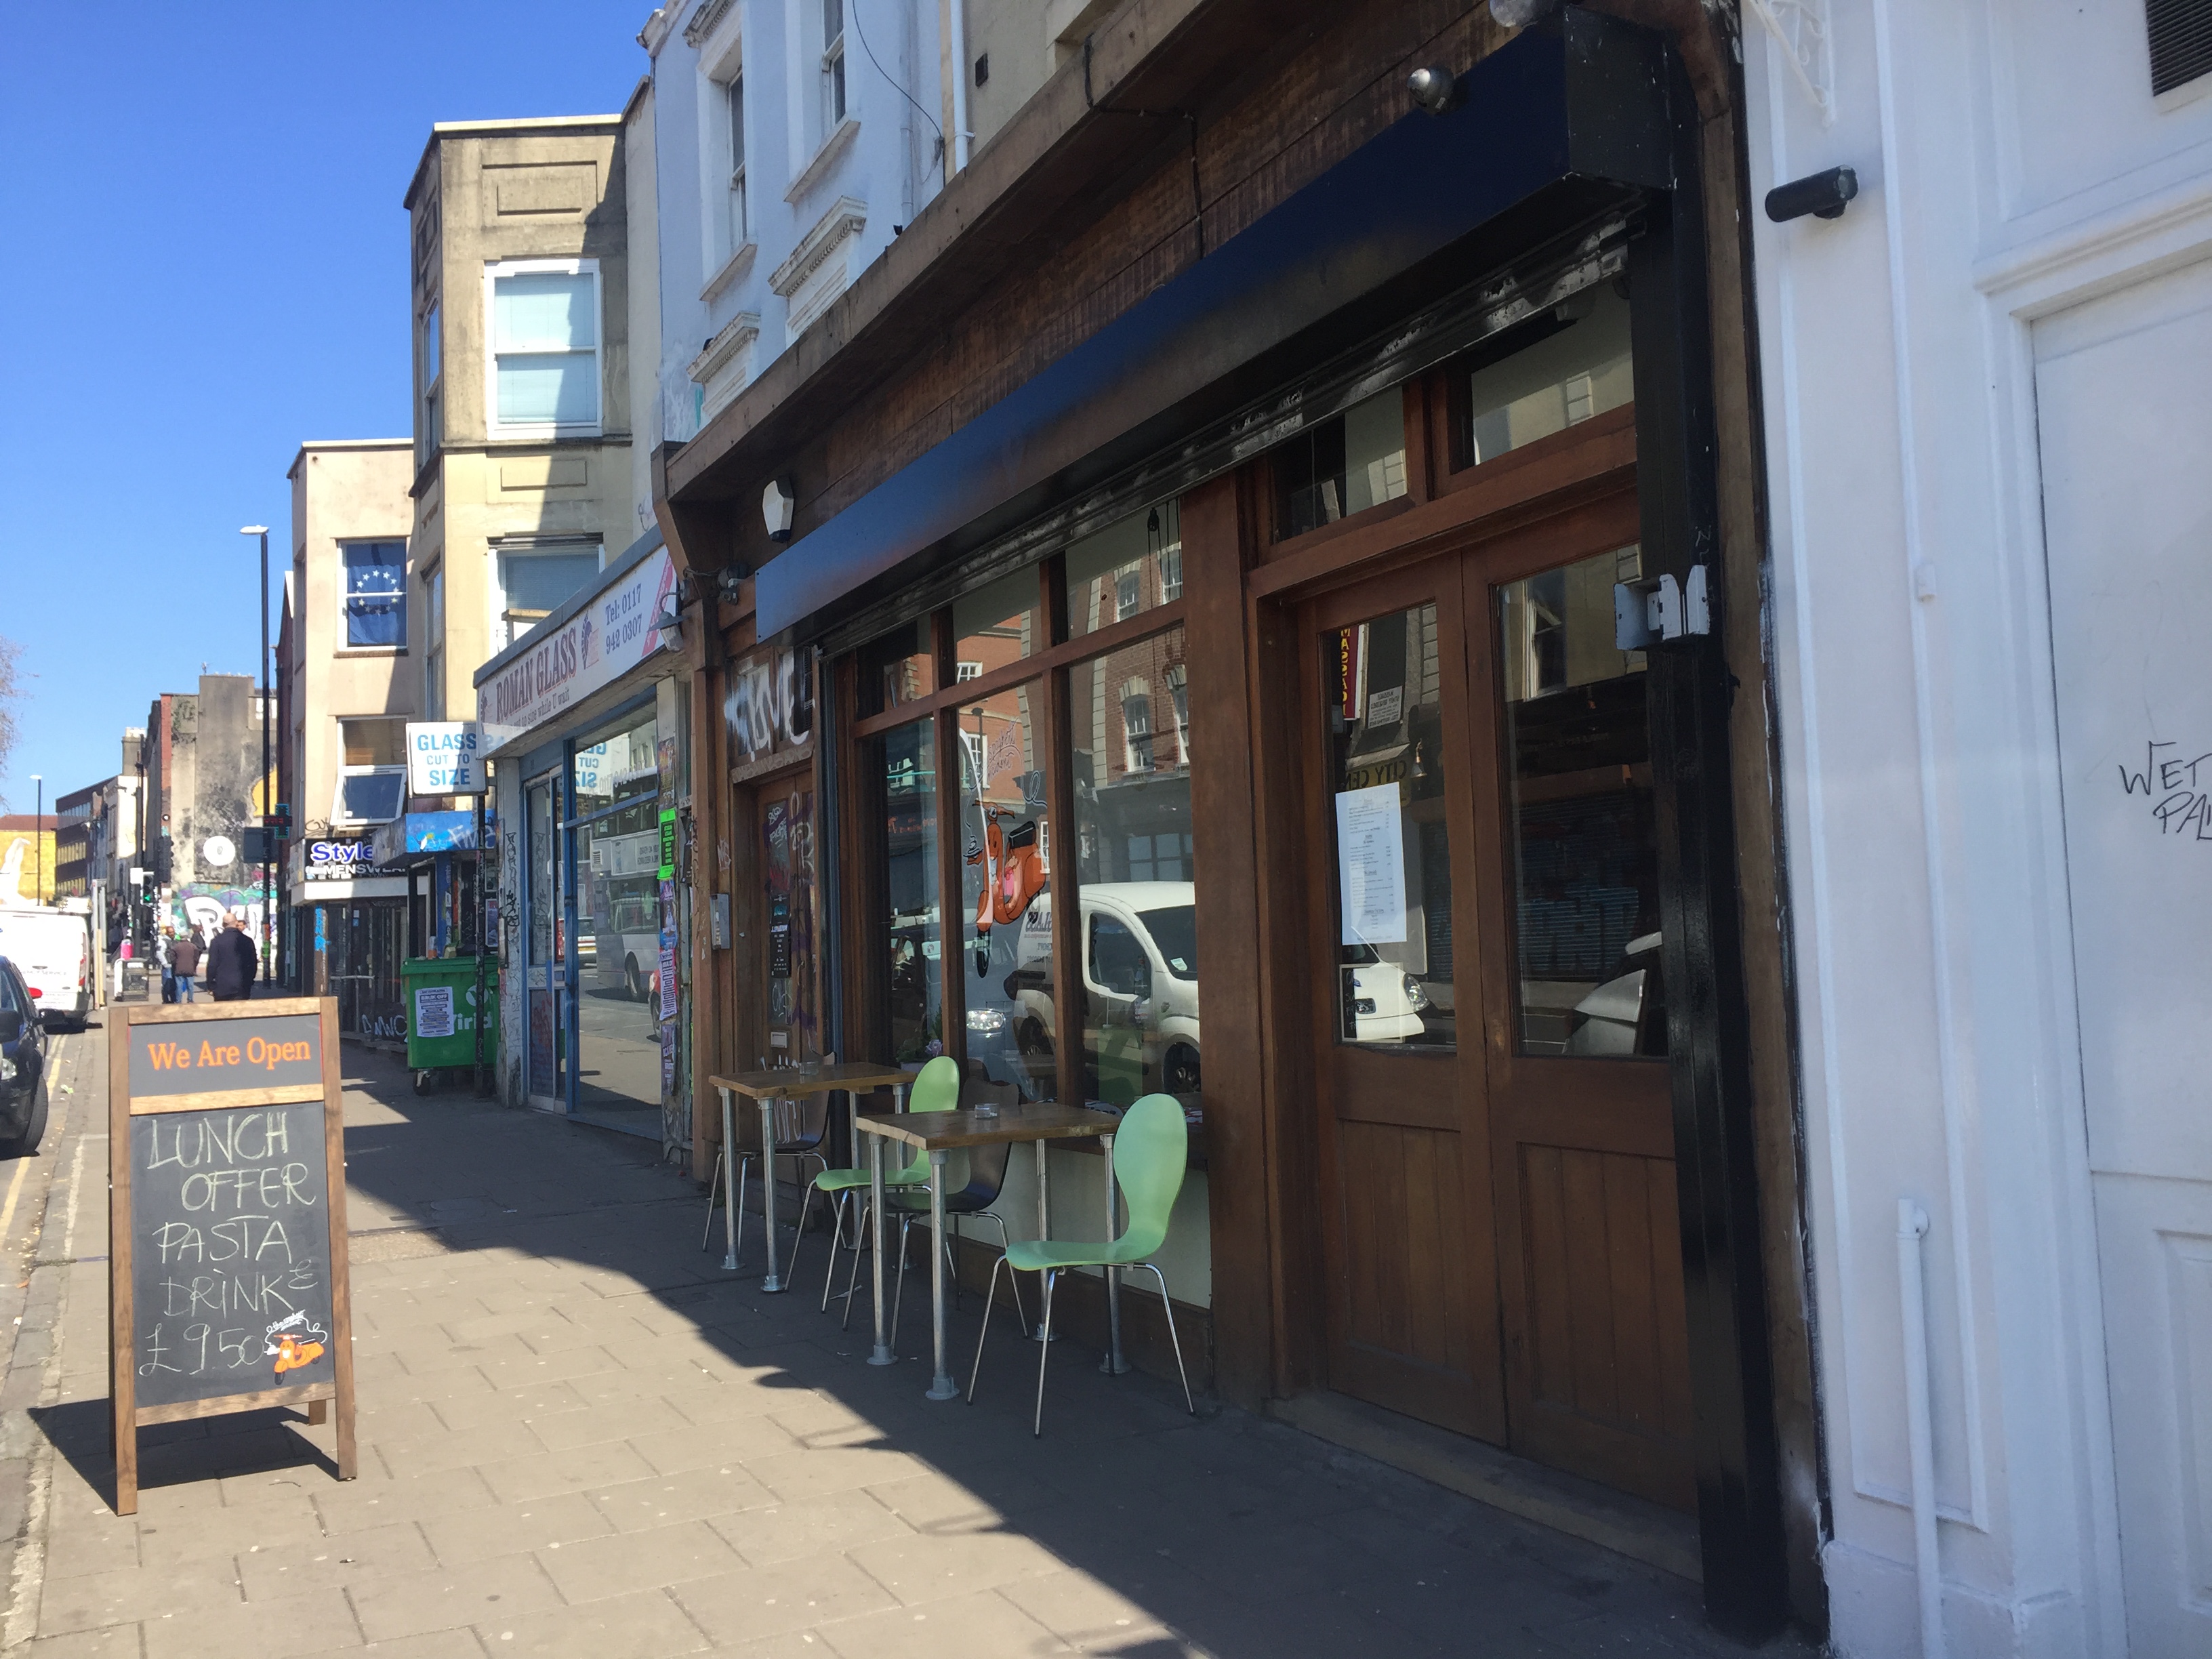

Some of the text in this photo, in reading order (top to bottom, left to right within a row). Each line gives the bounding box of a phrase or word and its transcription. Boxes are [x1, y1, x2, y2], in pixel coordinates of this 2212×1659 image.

[605, 583, 642, 626] Tel: 0117
[606, 613, 642, 655] 942 0307
[496, 627, 577, 724] ROMAN GLASS
[417, 733, 476, 751] GLASS
[427, 754, 470, 765] CUT TO
[429, 768, 470, 786] SIZE
[2118, 740, 2212, 796] WET
[148, 1037, 311, 1071] We Are Open
[147, 1111, 289, 1169] LUNCH
[181, 1162, 316, 1211] OFFER
[152, 1214, 293, 1264] PASTA
[159, 1268, 294, 1319] DRINK
